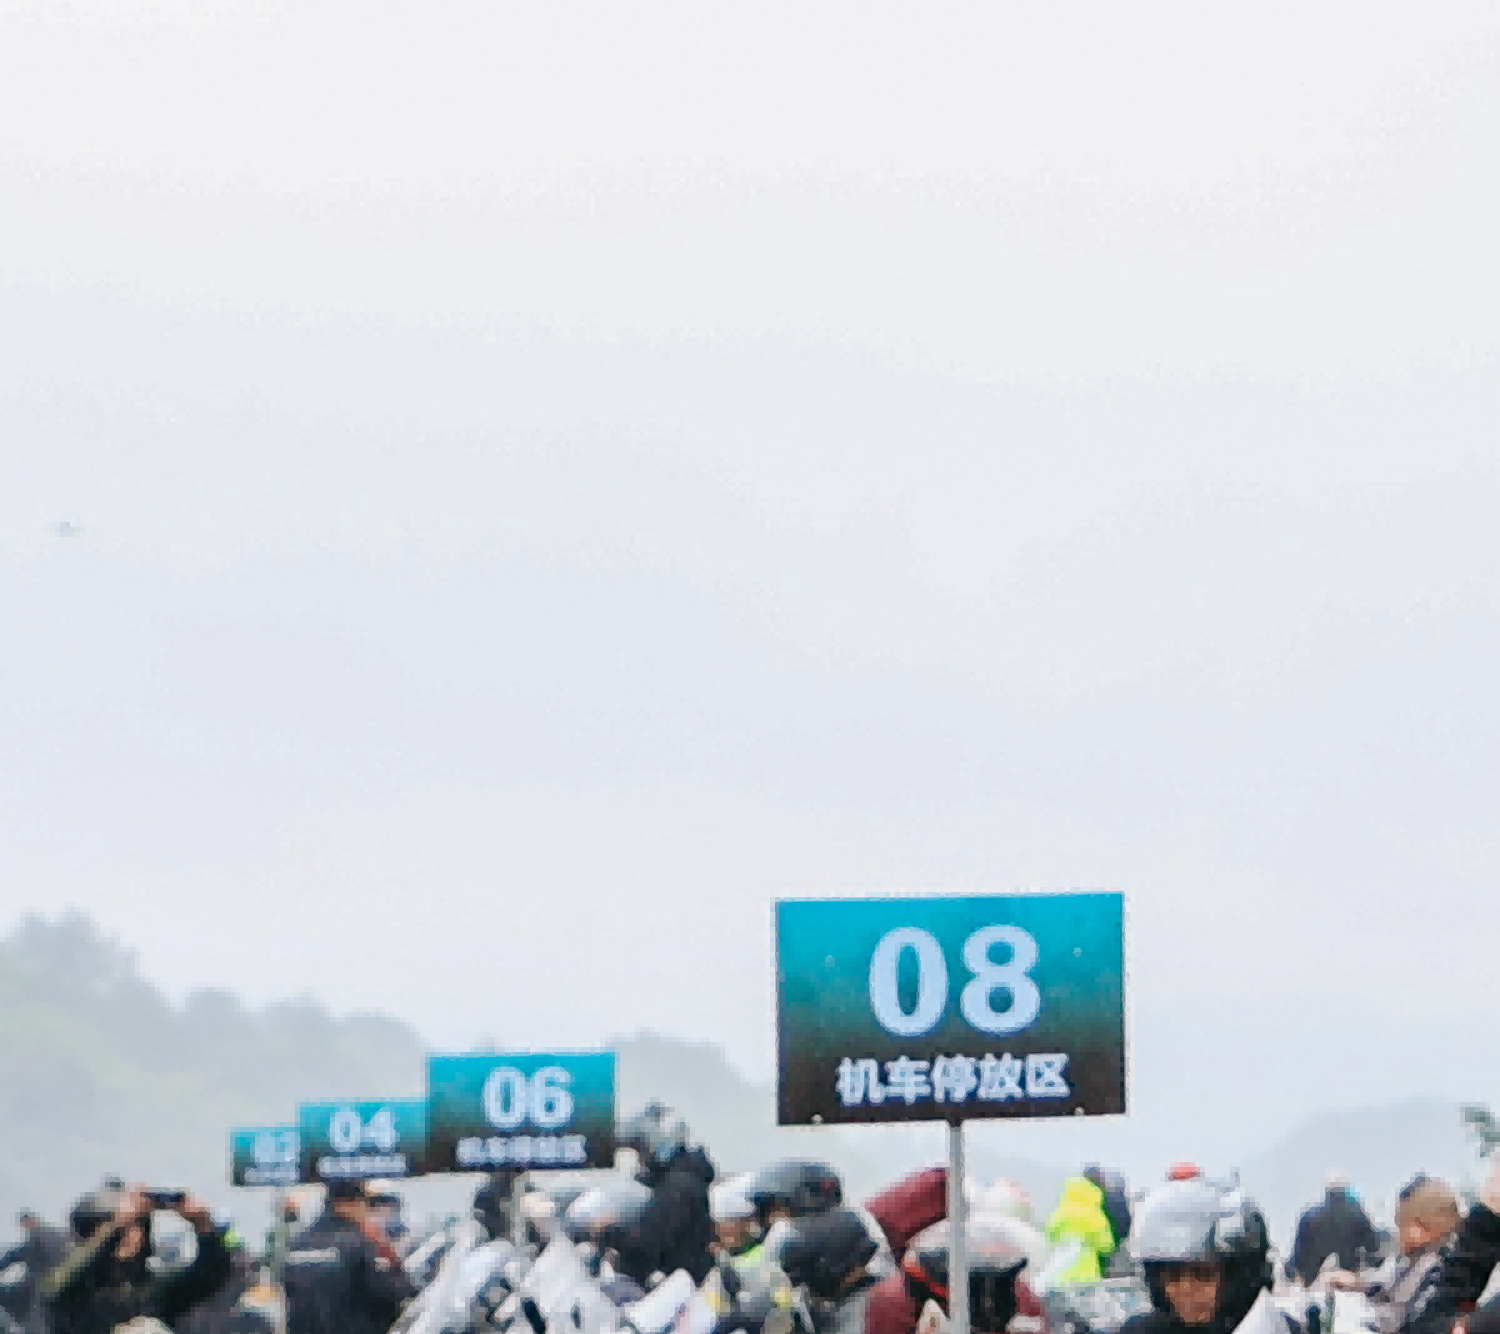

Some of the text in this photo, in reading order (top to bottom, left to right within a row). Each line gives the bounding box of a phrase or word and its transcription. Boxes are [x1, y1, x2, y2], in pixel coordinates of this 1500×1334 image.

[868, 925, 1041, 1037] 08
[482, 1065, 575, 1129] 06
[835, 1052, 1071, 1106] 机车停放区
[328, 1107, 397, 1153] 04
